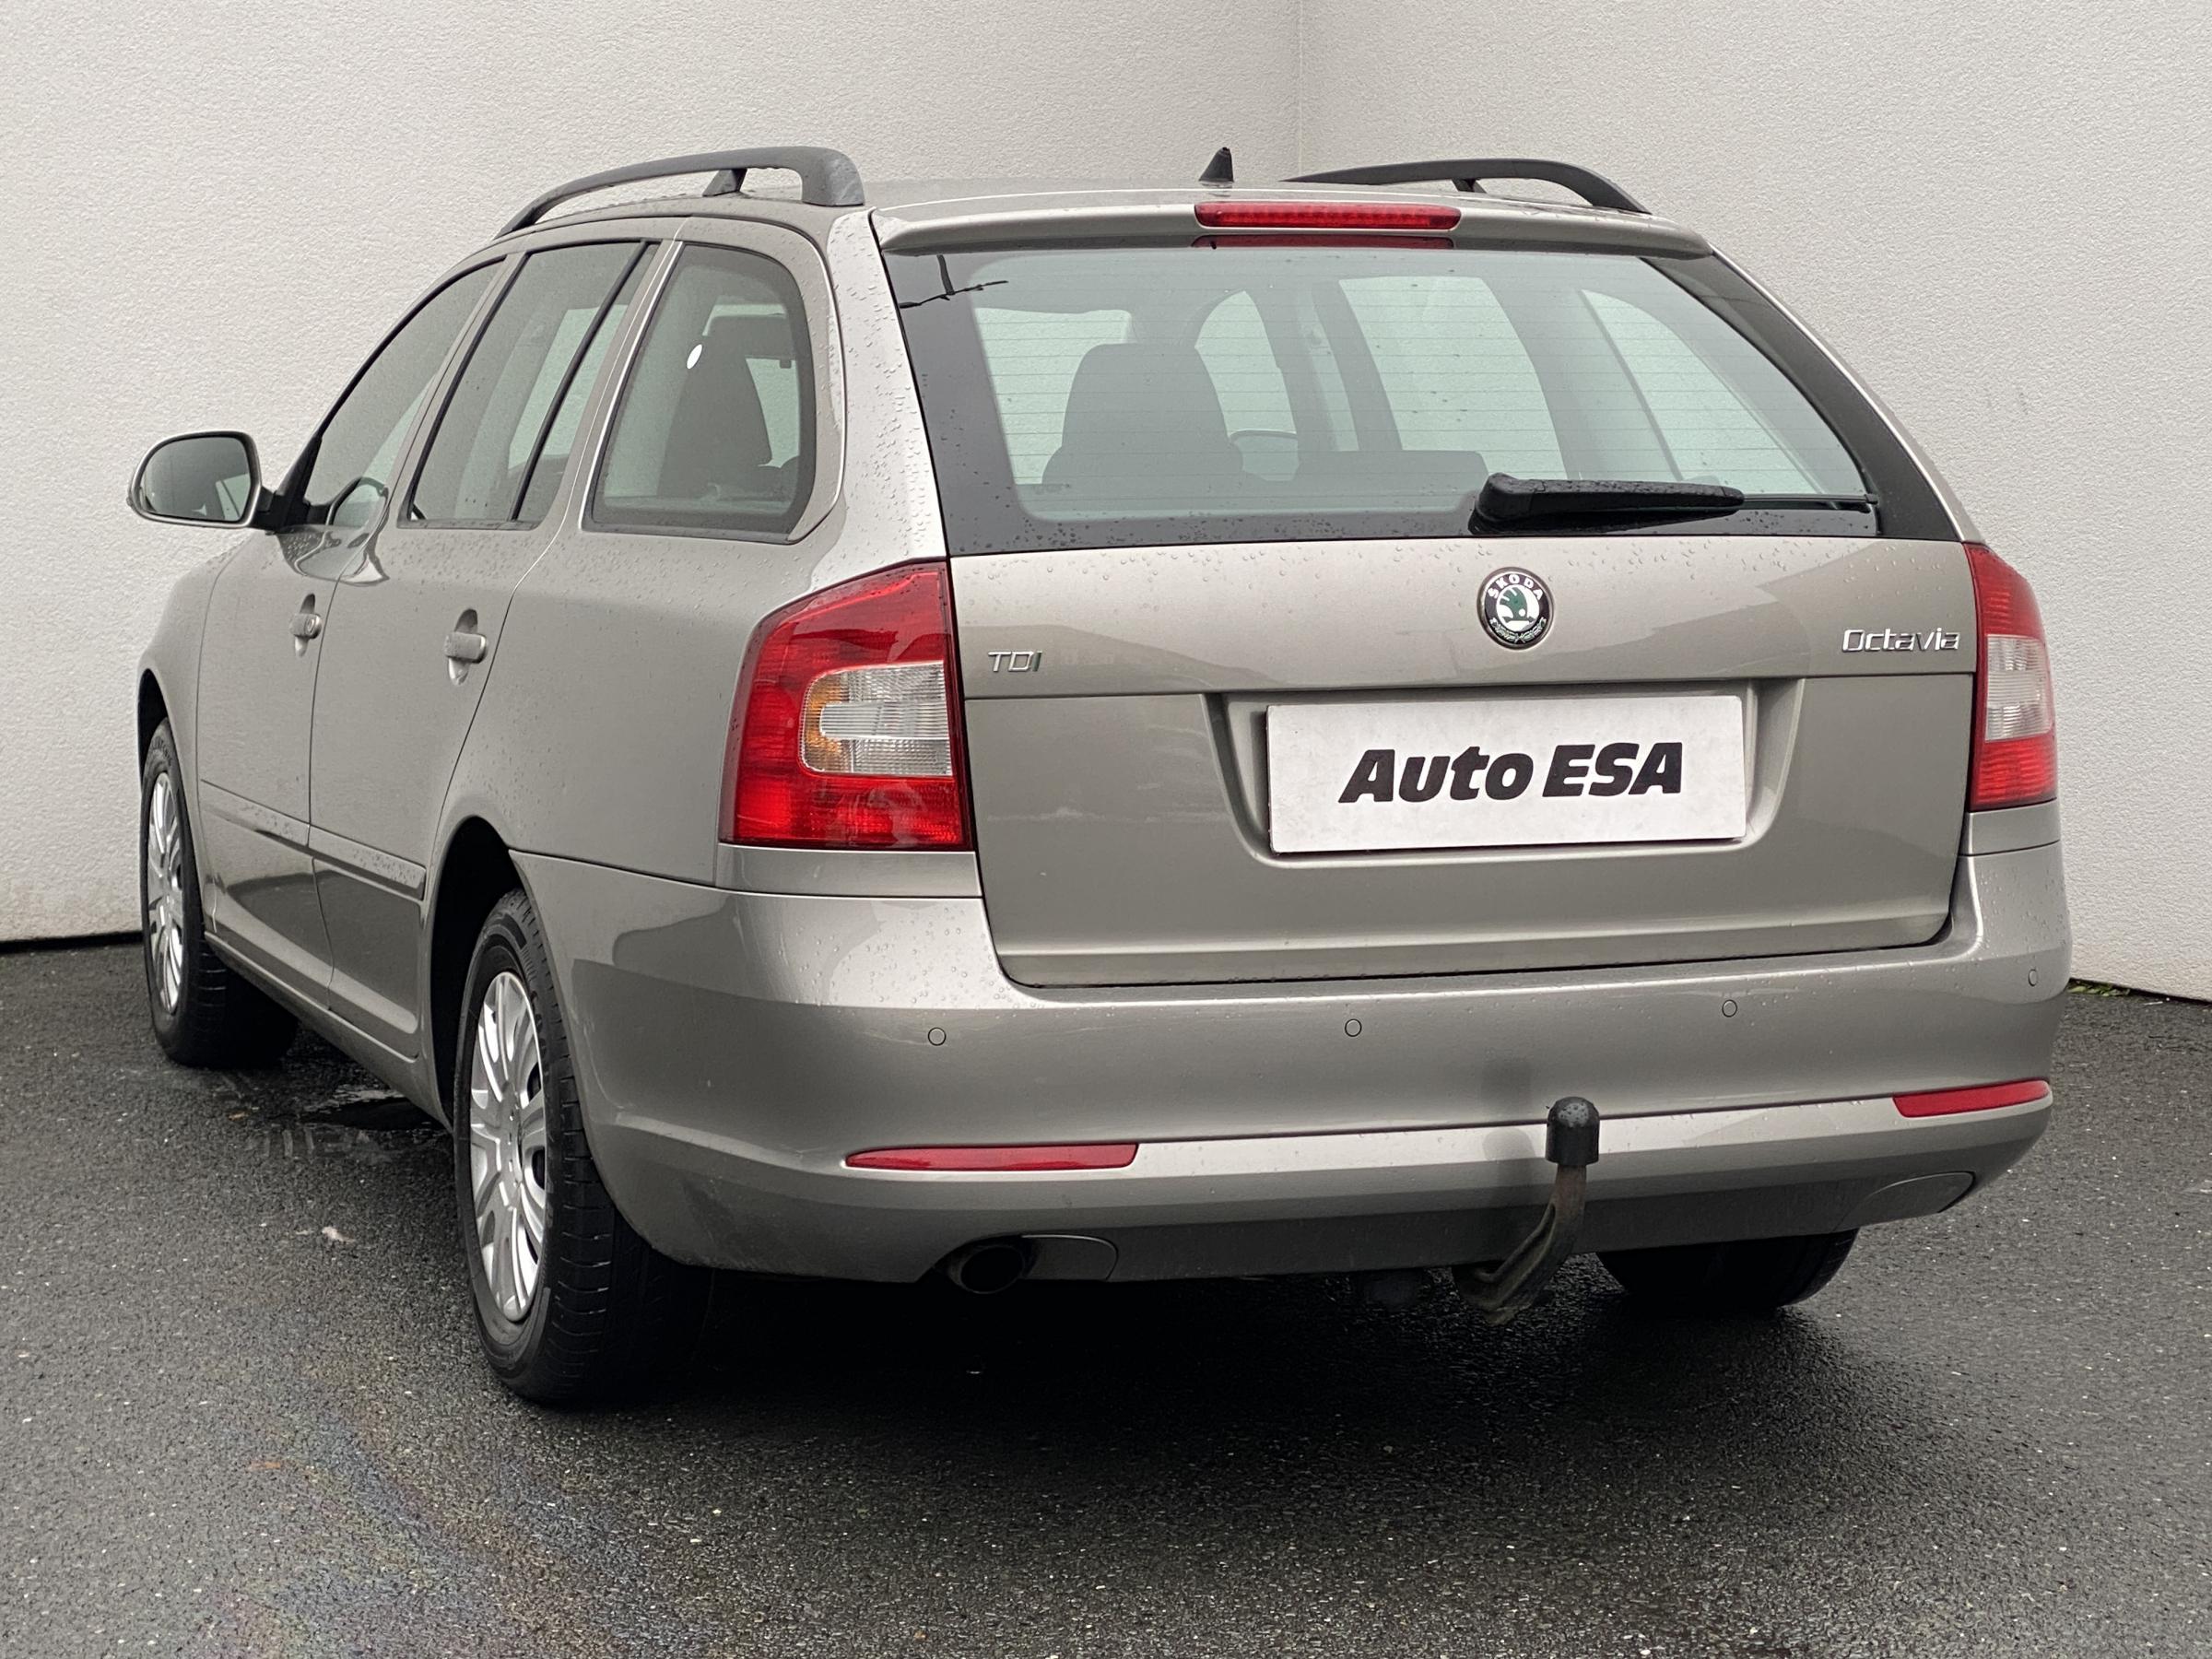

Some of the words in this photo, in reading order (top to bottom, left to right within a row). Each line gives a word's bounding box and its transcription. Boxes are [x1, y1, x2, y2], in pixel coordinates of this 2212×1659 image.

[1842, 628, 1960, 652] Octavia
[988, 650, 1043, 672] TDI
[1338, 746, 1534, 803] Auto
[1542, 742, 1682, 797] ESA
